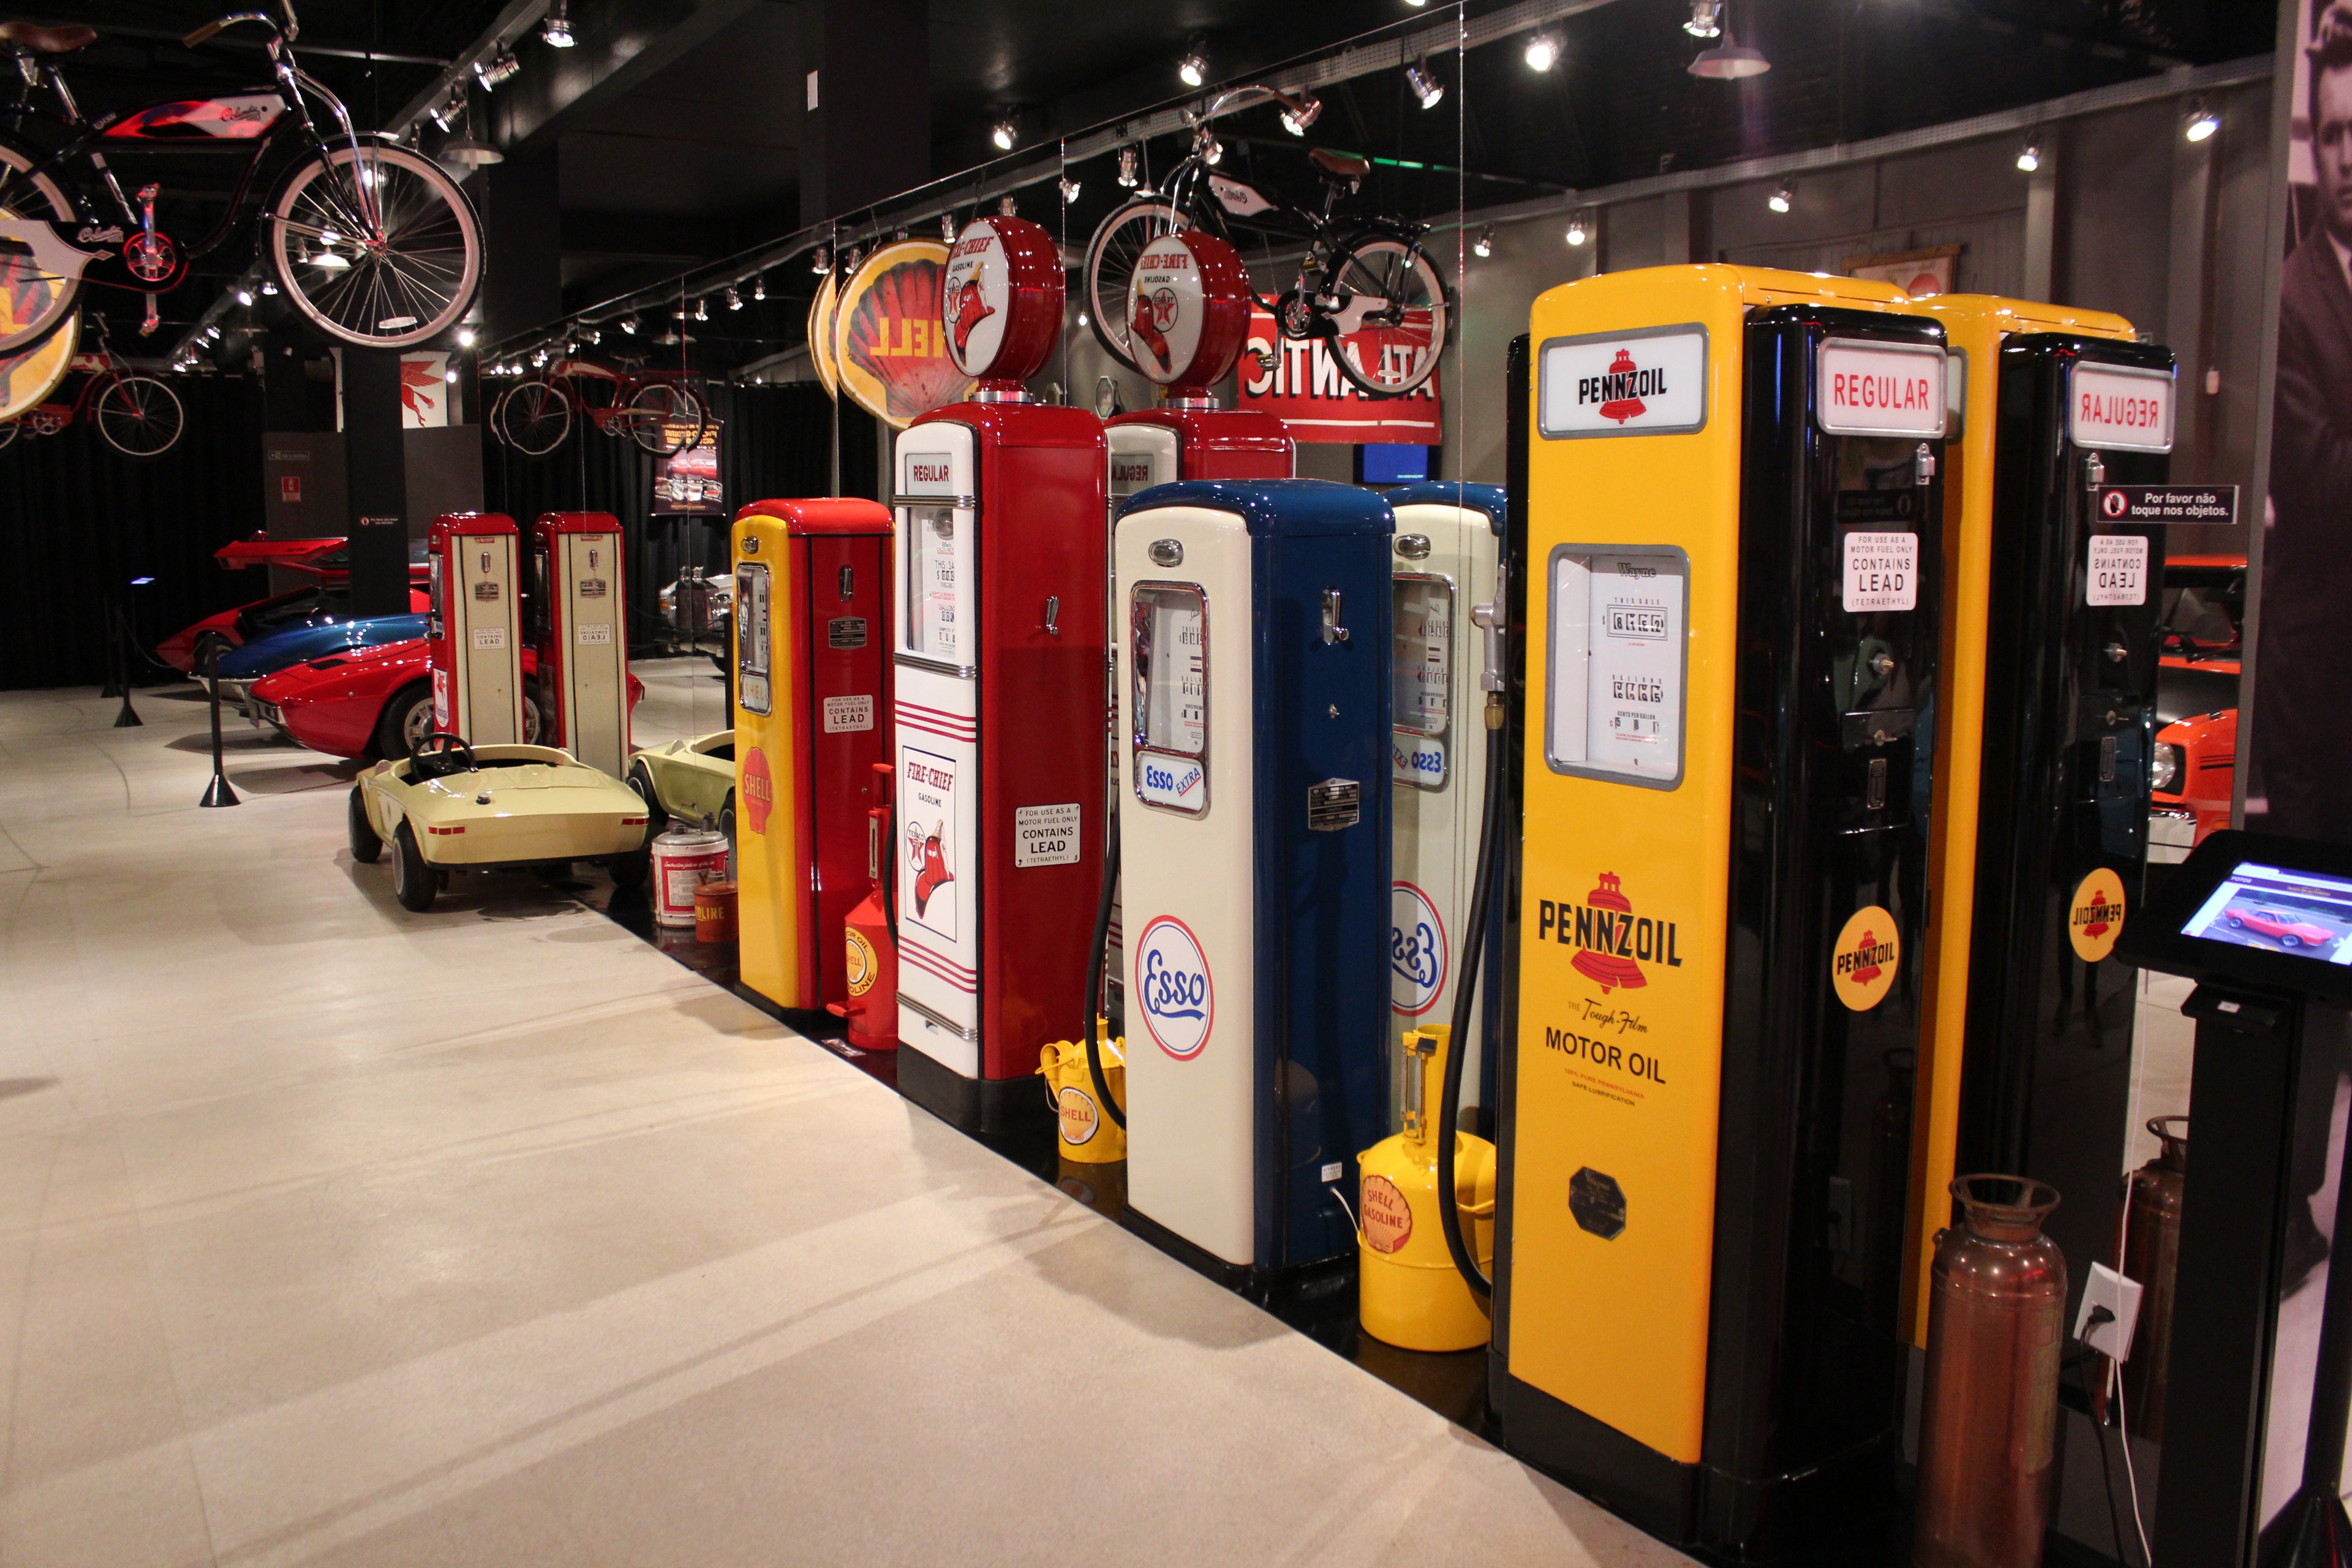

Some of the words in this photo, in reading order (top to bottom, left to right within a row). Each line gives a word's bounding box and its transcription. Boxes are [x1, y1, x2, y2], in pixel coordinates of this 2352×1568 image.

[952, 261, 973, 273] GASOLINE
[1579, 368, 1667, 405] PENNZOIL
[1834, 374, 1928, 410] REGULAR
[914, 465, 949, 481] REGULAR
[2145, 492, 2164, 503] Por
[2166, 492, 2193, 503] favor
[2195, 492, 2217, 503] não
[2132, 505, 2161, 517] toque
[2186, 505, 2228, 518] objetos.
[935, 560, 945, 570] THIS
[1618, 562, 1657, 580] Wayne
[1853, 559, 1910, 570] CONTAINS
[1860, 574, 1904, 592] LEAD
[829, 706, 868, 715] CONTAINS
[834, 714, 864, 724] LEAD
[907, 761, 953, 791] FIRE-CHIEF
[1176, 767, 1200, 794] EXTRA
[745, 774, 771, 802] SHELL
[918, 793, 941, 807] GASOLINE
[908, 829, 925, 841] TEXACO
[1023, 827, 1073, 839] CONTAINS
[1031, 840, 1066, 854] LEAD
[1539, 899, 1683, 968] PENNZOIL
[1837, 942, 1894, 975] PENNZOIL
[1145, 949, 1205, 1021] Esso
[1568, 1001, 1581, 1011] THE
[1547, 1027, 1621, 1071] MOTOR
[1629, 1053, 1666, 1085] OIL
[1580, 1072, 1597, 1084] PURE
[1572, 1081, 1588, 1091] SAFE
[1589, 1087, 1635, 1106] LUBRIFICATION
[1060, 1107, 1091, 1122] SHELL
[1368, 1189, 1393, 1210] SHELL
[1364, 1204, 1403, 1229] GASOLINE
